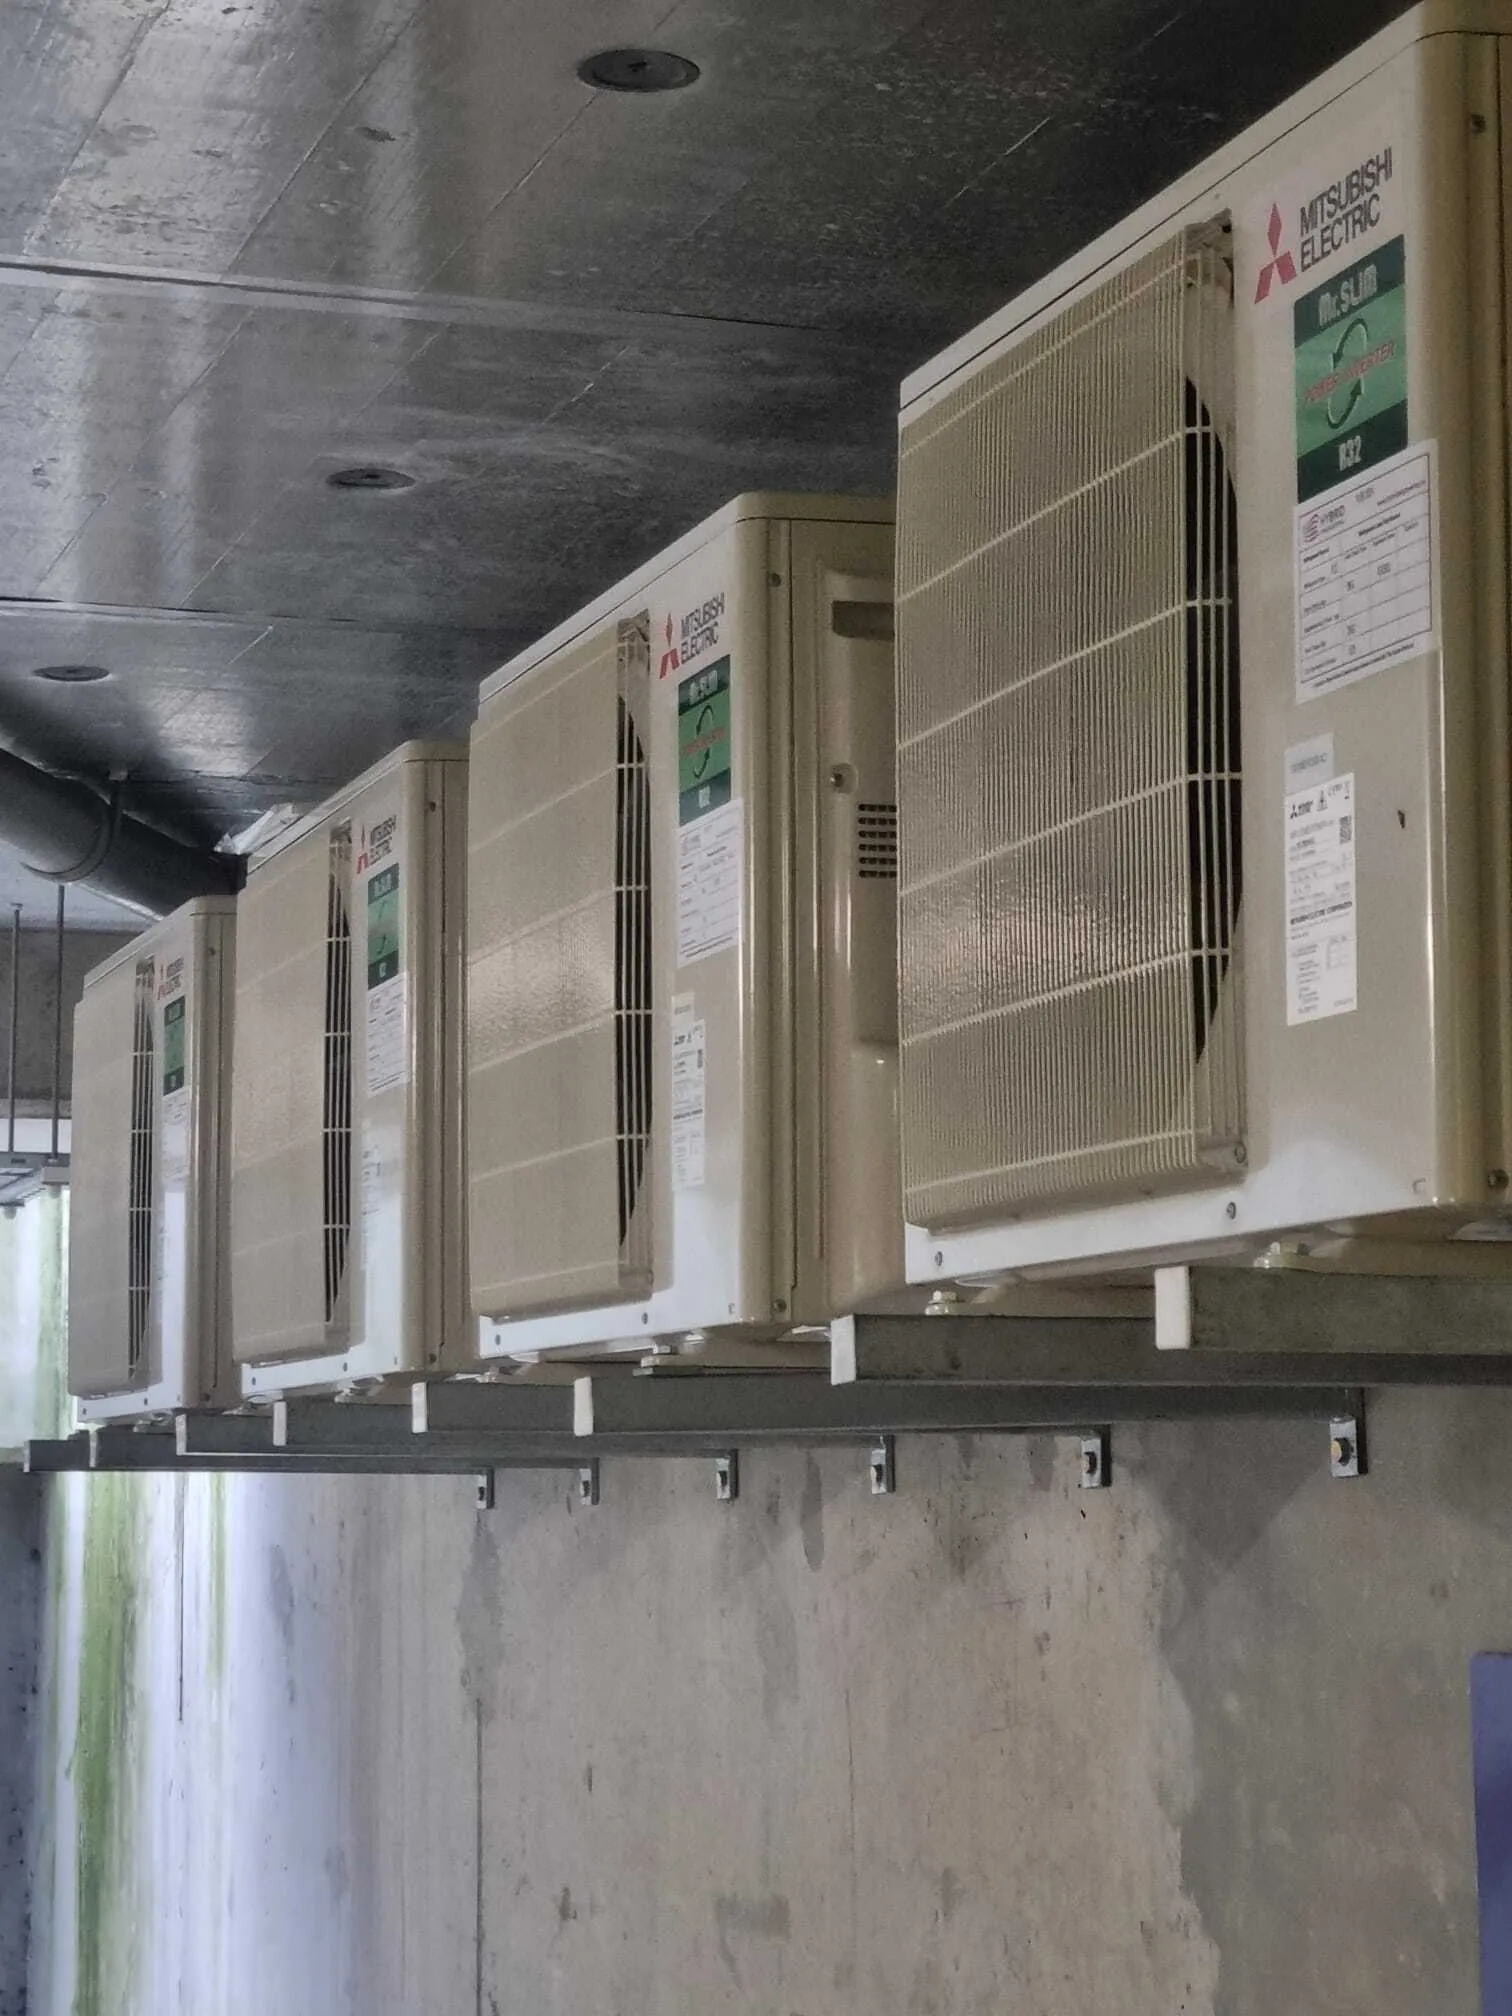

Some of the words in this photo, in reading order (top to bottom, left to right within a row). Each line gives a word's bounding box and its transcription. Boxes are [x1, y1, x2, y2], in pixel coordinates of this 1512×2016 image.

[1300, 146, 1392, 236] MITSUBISHI
[1301, 193, 1380, 272] ELECTRIC
[1338, 435, 1362, 471] R32
[681, 592, 725, 639] MITSUBISHI
[681, 621, 719, 665] ELECTRIC
